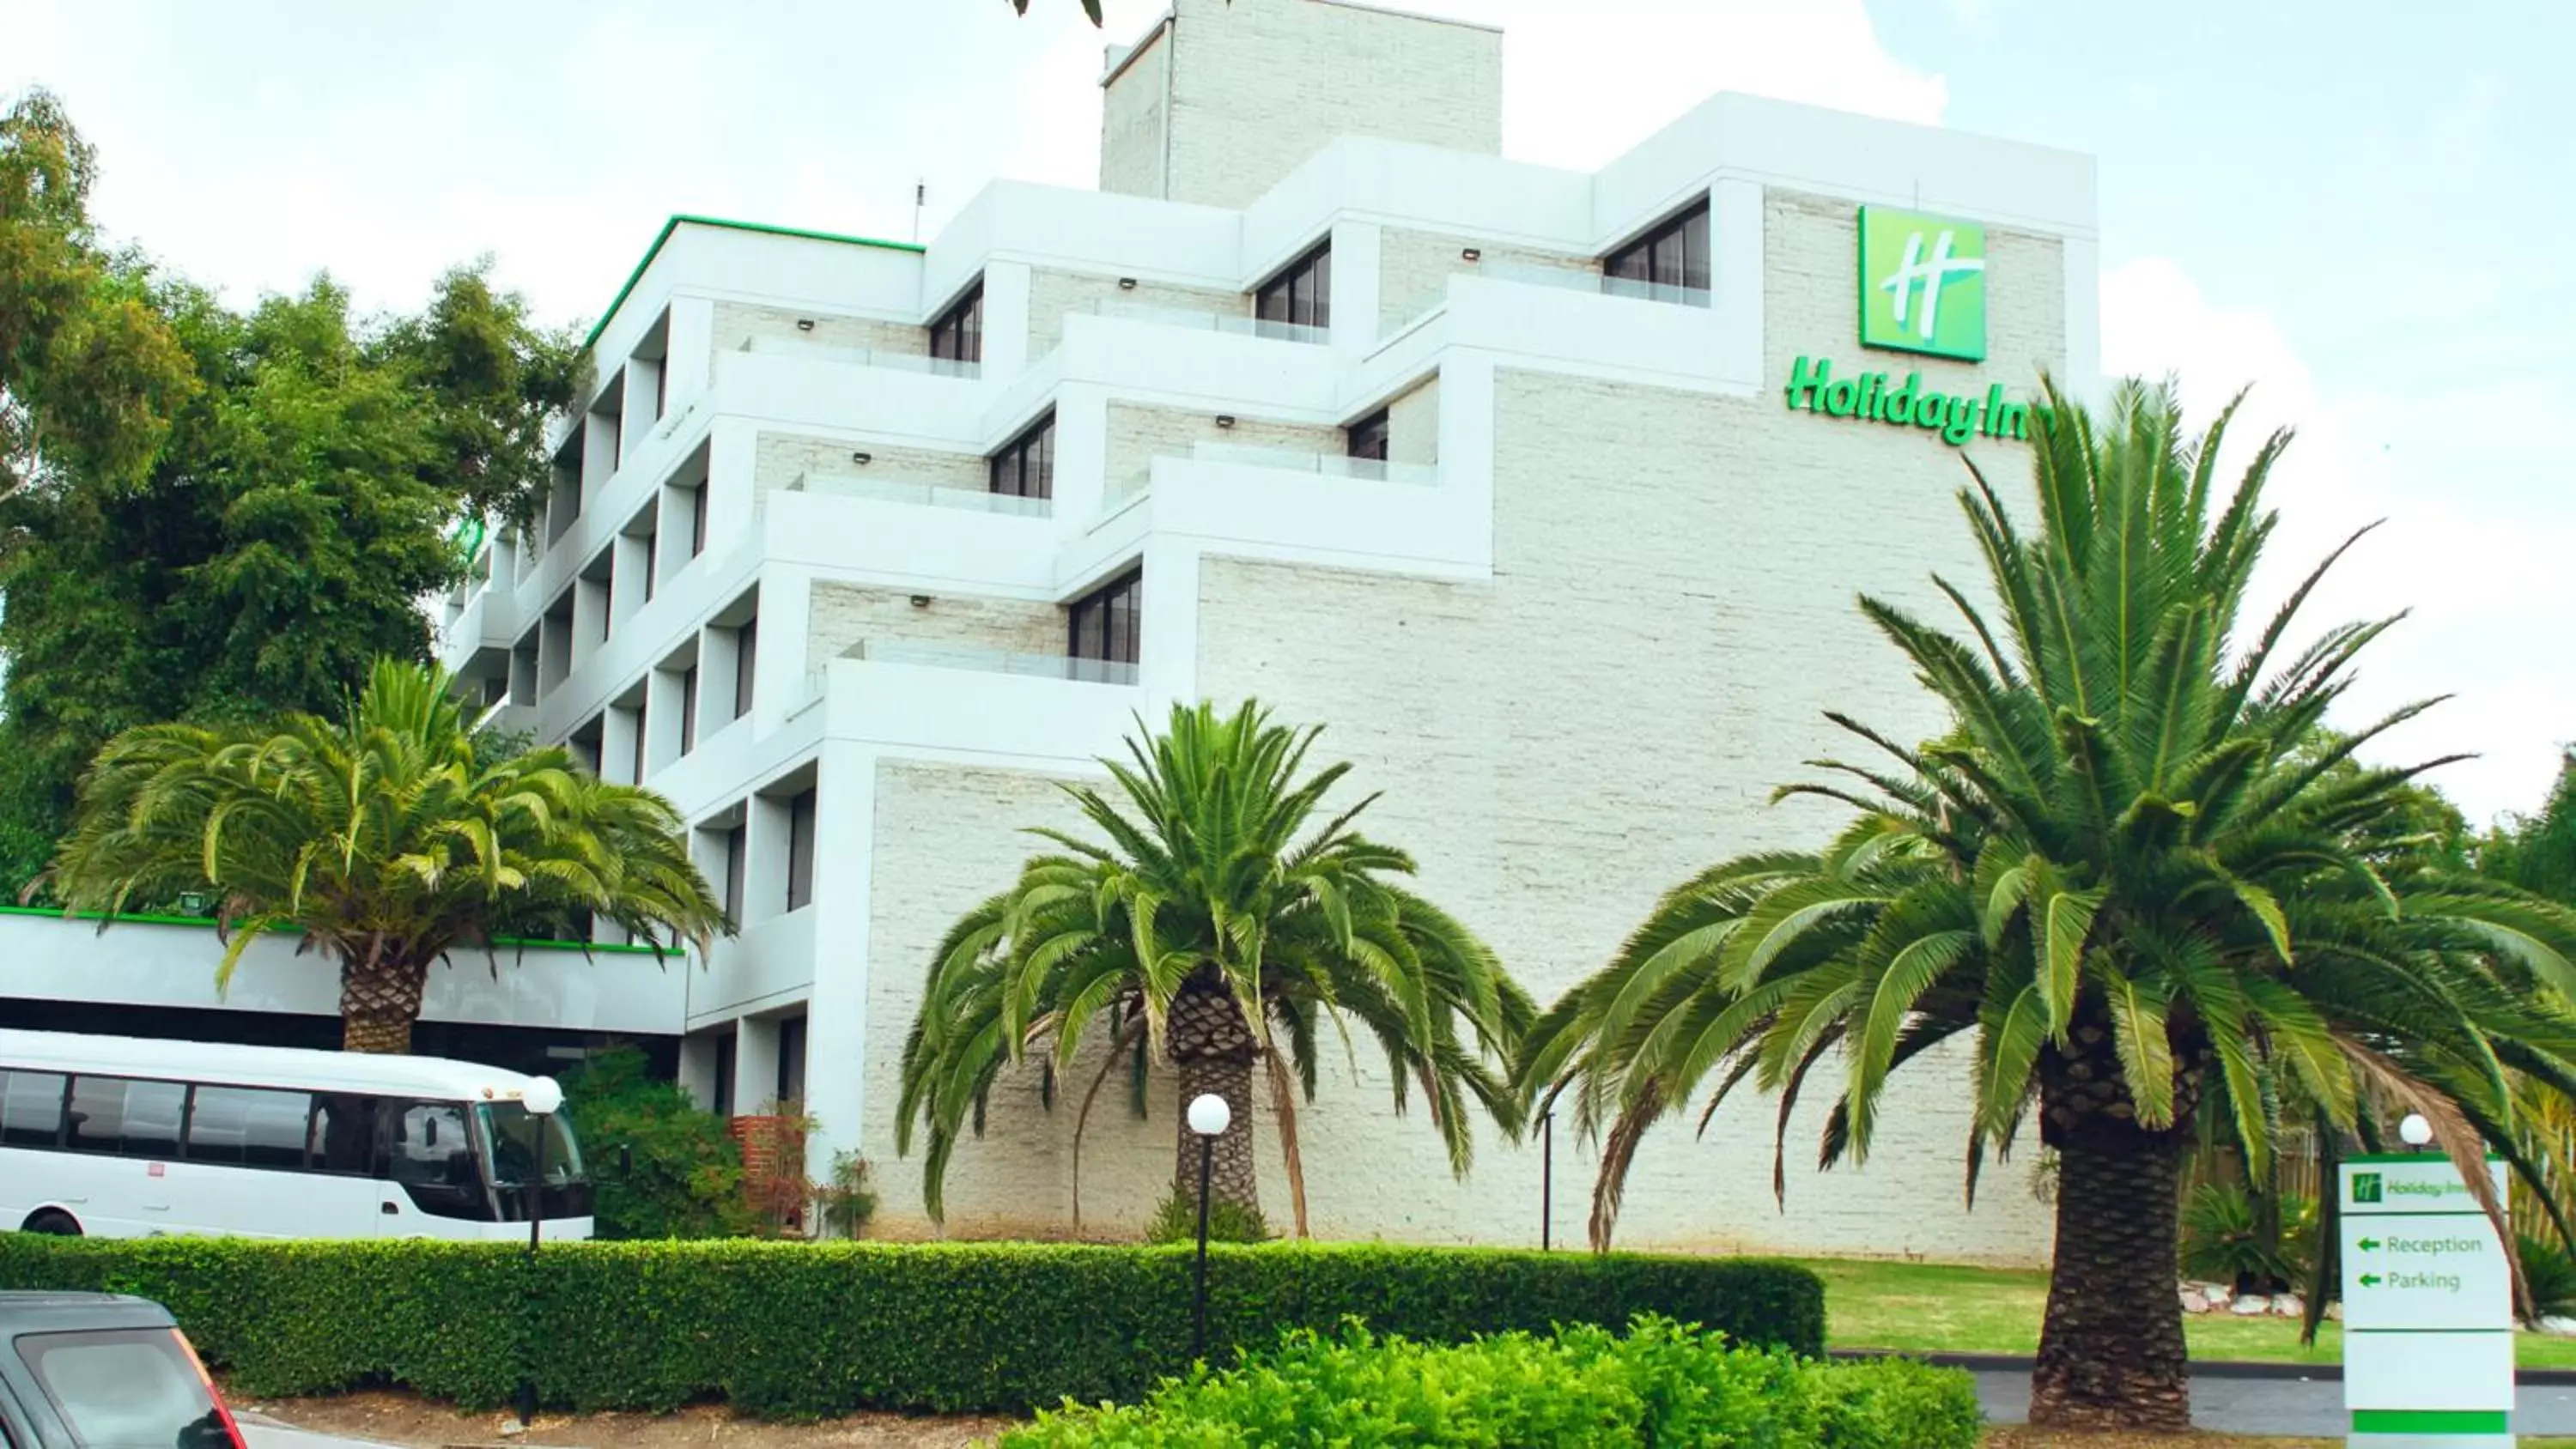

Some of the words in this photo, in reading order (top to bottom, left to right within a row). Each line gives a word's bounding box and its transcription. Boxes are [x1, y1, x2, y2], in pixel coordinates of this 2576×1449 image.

[1786, 355, 1979, 446] Holiday
[2387, 1179, 2442, 1198] Holiday
[2387, 1235, 2482, 1257] Reception
[2388, 1271, 2461, 1294] Parking
